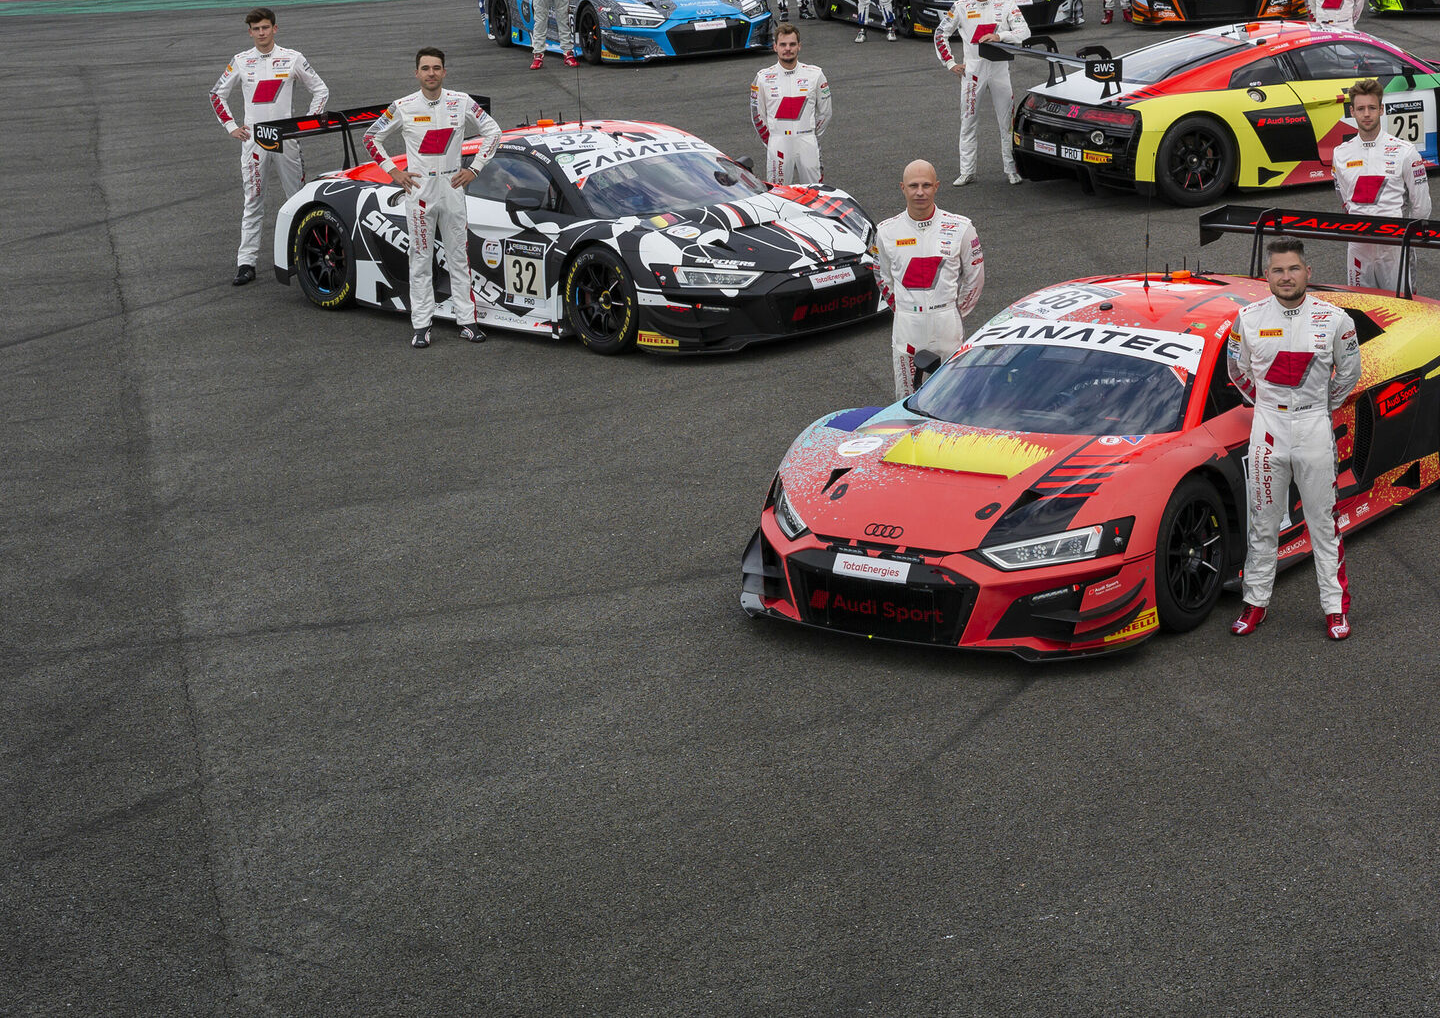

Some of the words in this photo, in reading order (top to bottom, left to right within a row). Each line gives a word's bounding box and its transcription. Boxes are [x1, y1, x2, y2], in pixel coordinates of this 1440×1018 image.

[1094, 62, 1115, 73] aws
[1067, 105, 1080, 119] 25
[1267, 117, 1284, 125] Audi
[1285, 116, 1307, 124] Sport
[257, 125, 278, 141] aws
[1393, 115, 1419, 142] 25
[557, 133, 597, 146] 32
[573, 141, 708, 176] FANATEC
[1064, 147, 1078, 160] PRO
[1292, 217, 1373, 232] Audi
[512, 259, 538, 296] 32
[566, 261, 578, 302] PIRELLI
[815, 271, 851, 284] TotalEnergies
[524, 297, 536, 306] PRO
[810, 299, 839, 315] Audi
[842, 290, 874, 310] Sport
[1038, 290, 1093, 310] 66
[639, 331, 675, 345] PIRELLI
[974, 324, 1194, 360] FANATEC
[1386, 395, 1400, 409] Audi
[1400, 385, 1418, 401] Sport
[1265, 446, 1273, 471] Audi
[1263, 475, 1274, 505] Sport
[841, 560, 900, 578] TotalEnergies
[832, 593, 878, 617] Audi
[884, 600, 943, 625] Sport
